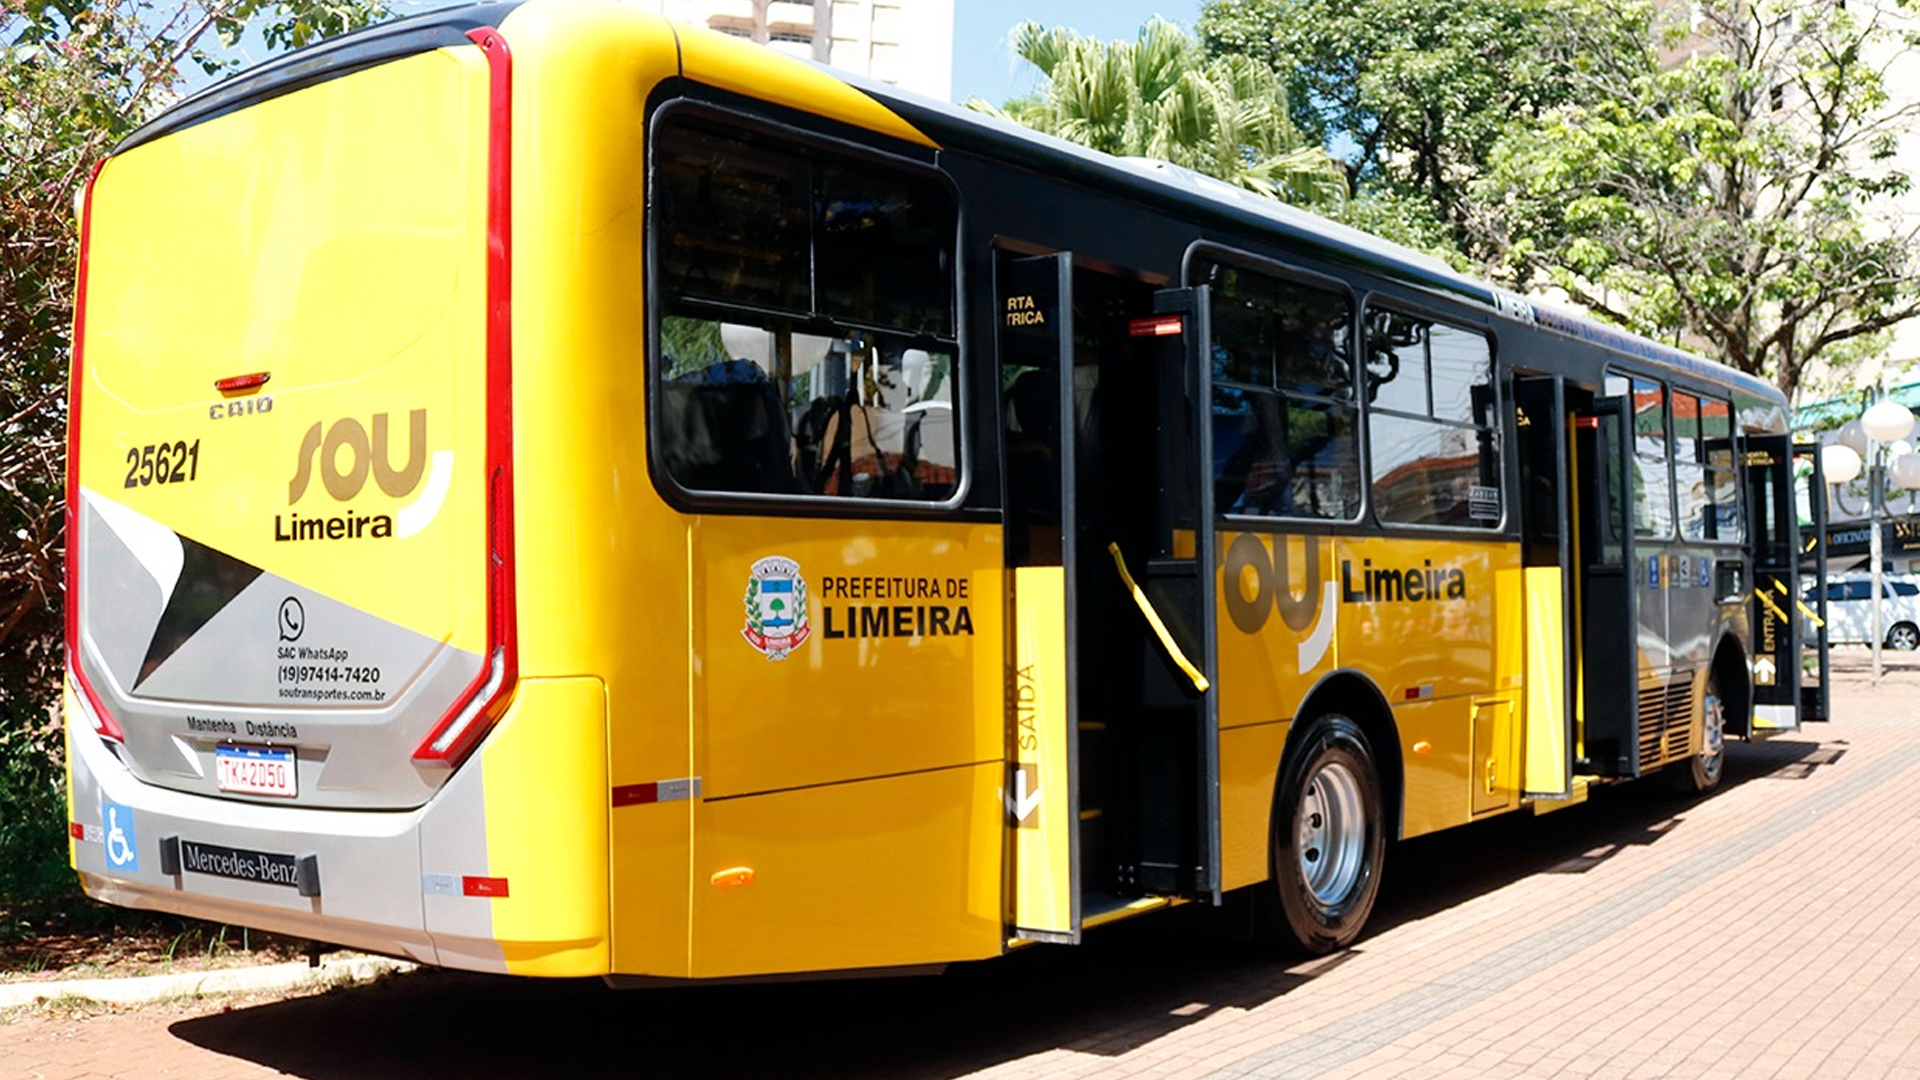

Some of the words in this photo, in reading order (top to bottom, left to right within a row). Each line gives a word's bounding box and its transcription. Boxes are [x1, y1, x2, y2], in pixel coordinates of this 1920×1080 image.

[1006, 295, 1035, 311] RTA
[1006, 310, 1045, 326] TRICA
[209, 396, 273, 420] CAIO
[124, 438, 200, 489] 25621
[289, 408, 427, 506] SOU
[274, 510, 393, 542] Limeira
[822, 577, 941, 599] PREFEITURA
[946, 578, 968, 598] DE
[1216, 532, 1321, 635] OU
[1342, 559, 1466, 604] Limeira
[823, 606, 974, 639] LIMEIRA
[277, 646, 297, 660] SAC
[298, 647, 349, 662] WhatsApp
[278, 666, 381, 685] (19)97414-7420
[279, 687, 386, 701] soutransportes.com.br
[186, 716, 237, 734] Mantenha
[246, 720, 298, 738] Distância
[223, 760, 286, 789] TKA2D50
[187, 845, 299, 885] Mercedes-Benz
